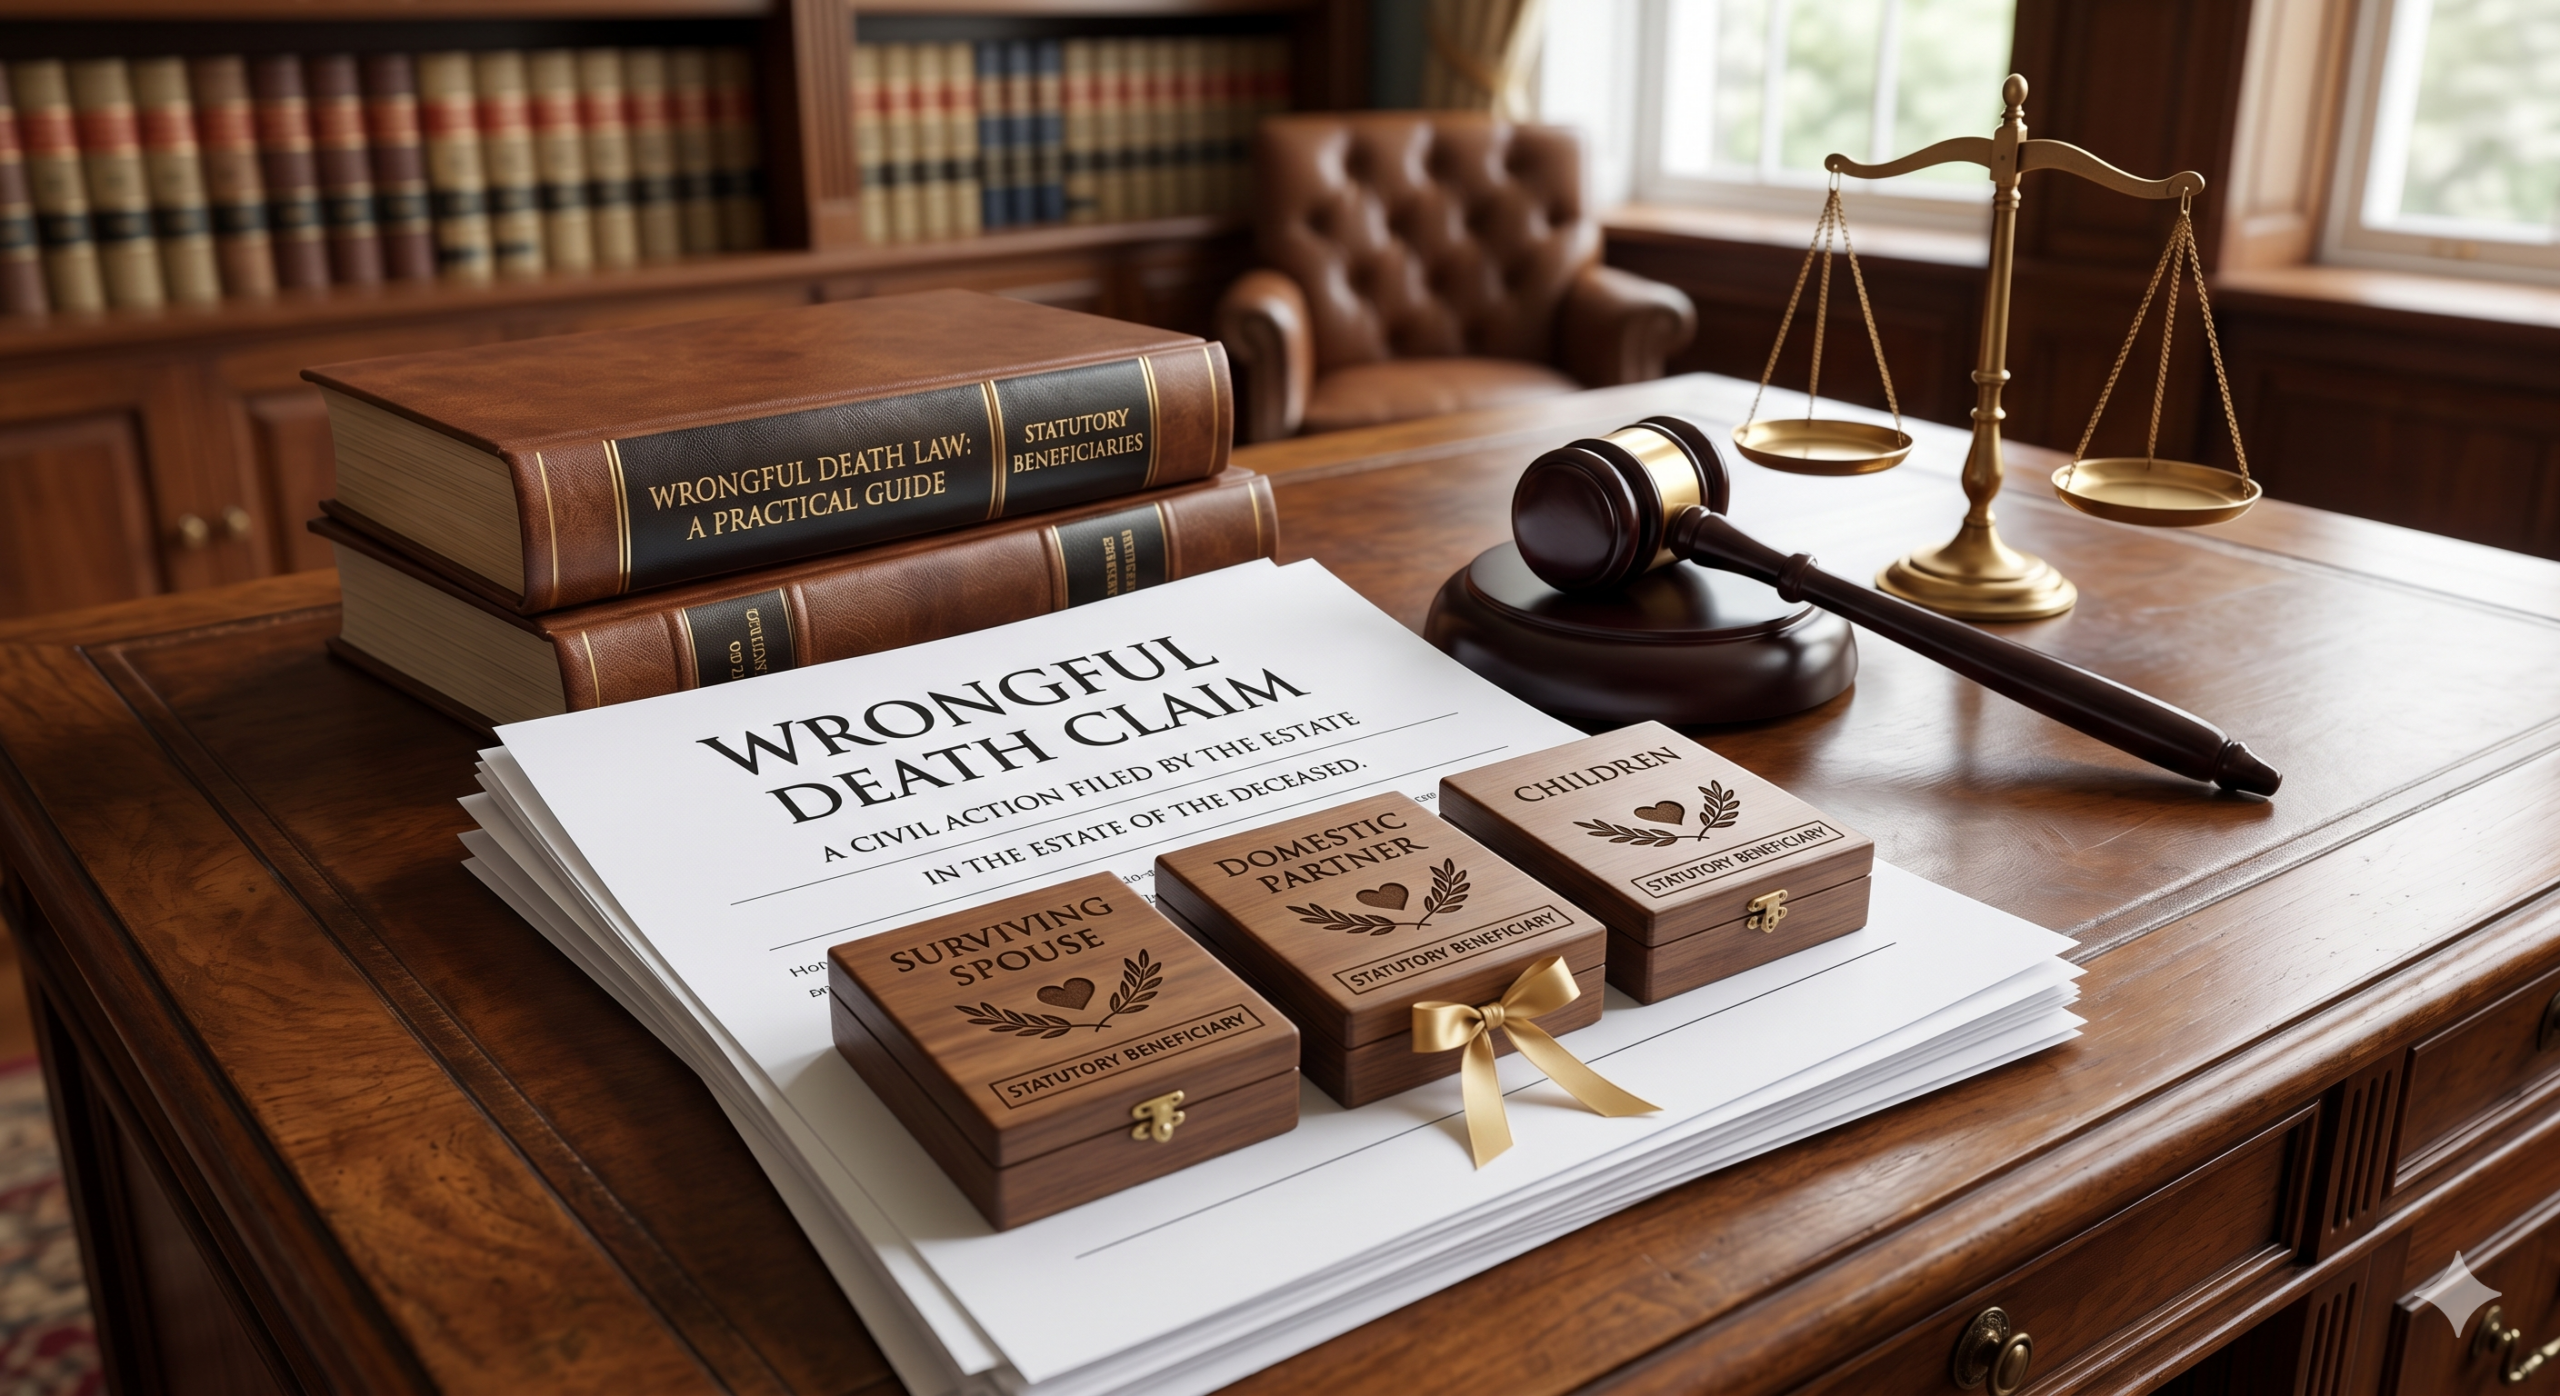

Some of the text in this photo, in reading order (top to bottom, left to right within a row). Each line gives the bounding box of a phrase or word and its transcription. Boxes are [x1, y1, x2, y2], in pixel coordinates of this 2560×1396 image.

[1013, 432, 1143, 474] BENEFICIARIES
[1024, 407, 1129, 444] STATUTORY
[648, 432, 972, 510] WRONGFUL DEATH LAW:
[686, 470, 946, 541] A PRACTICAL GUIDE
[696, 636, 1220, 776] WRONGFUL
[765, 668, 1310, 825] DEATH CLAIM
[1513, 746, 1682, 803] CHILDREN
[823, 711, 1361, 863] A CIVIL ACTION FILED BY THE ESTATE
[923, 759, 1367, 885] IN THE ESTATE OF THE DECEASED.
[1212, 811, 1408, 878] DOMESTIC
[1255, 836, 1430, 895] PARTNER
[1645, 825, 1827, 892] STATUTORY BENEFICIARY
[889, 895, 1114, 973] SURVIVING
[949, 927, 1105, 987] SPOUSE
[1349, 912, 1556, 987] STATUTORY BENEFICIARY
[1007, 1012, 1245, 1099] STATUTORY BENEFICIARY
